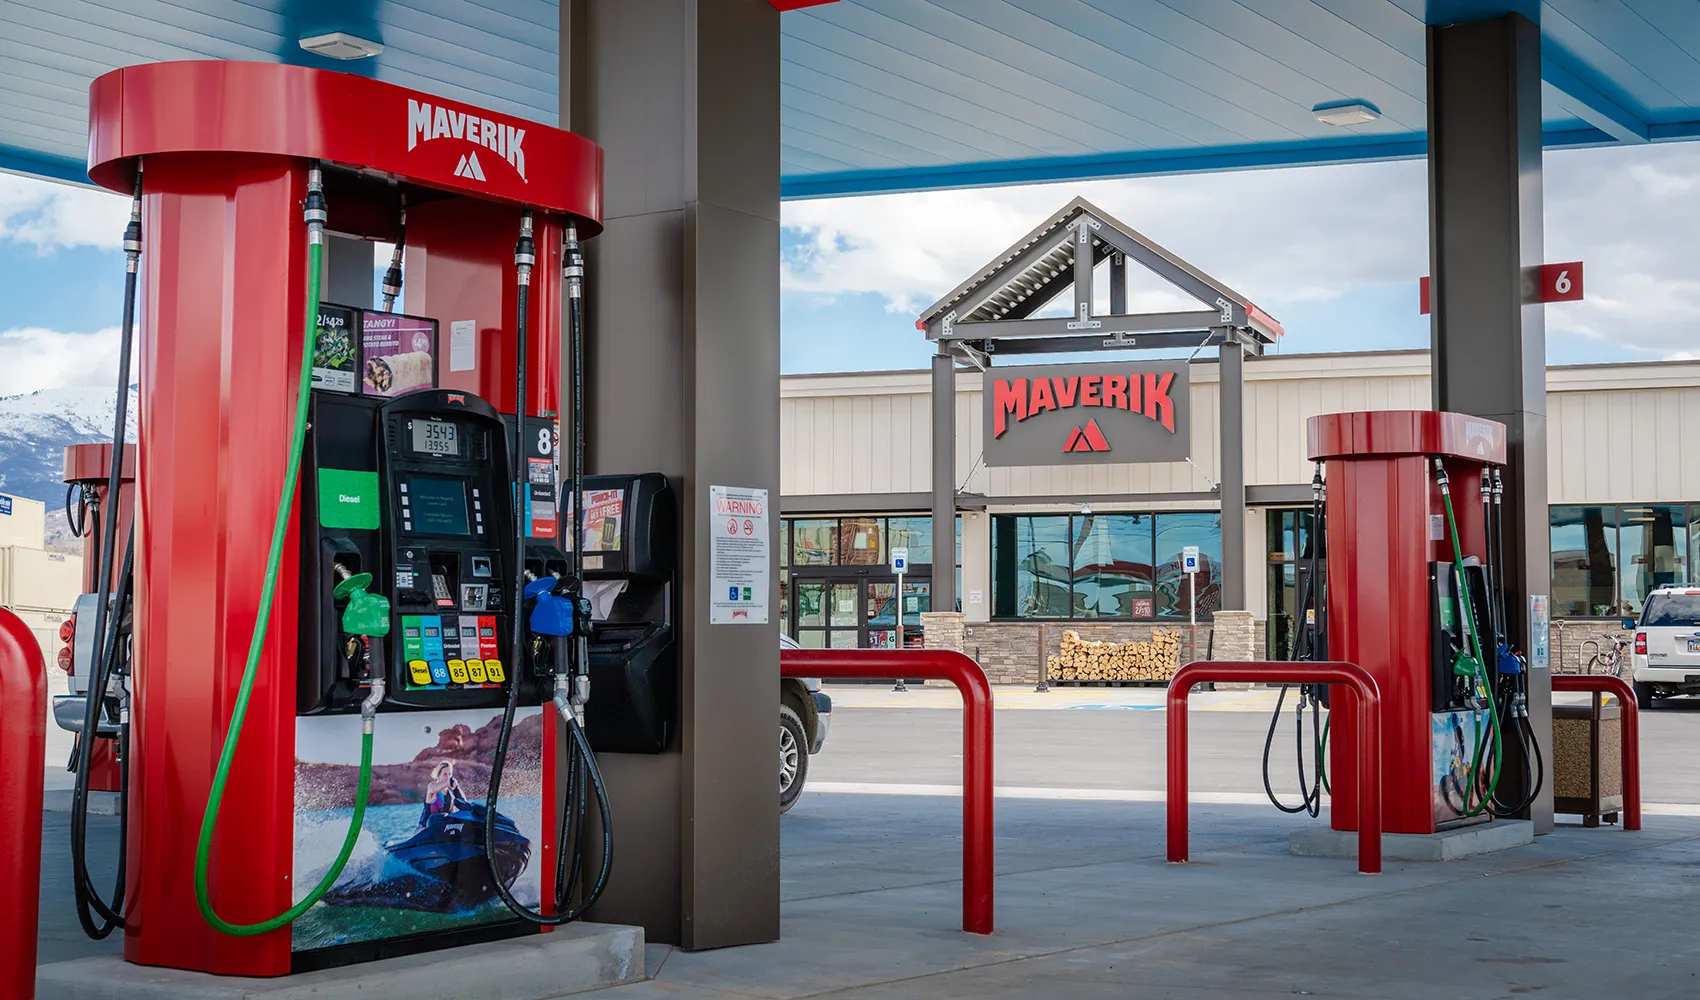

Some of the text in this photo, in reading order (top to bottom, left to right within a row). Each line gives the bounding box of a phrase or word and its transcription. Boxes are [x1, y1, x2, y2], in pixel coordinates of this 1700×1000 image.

[407, 98, 526, 182] MAVERIK
[1555, 271, 1571, 294] 6
[992, 372, 1176, 440] MAVERIK
[407, 421, 413, 430] $
[537, 428, 551, 454] 8
[338, 494, 360, 503] Diesel
[602, 502, 621, 517] FREE
[716, 499, 763, 515] WARNING
[433, 668, 446, 678] 88
[453, 668, 465, 678] 85
[471, 667, 482, 678] 87
[489, 667, 501, 678] 91
